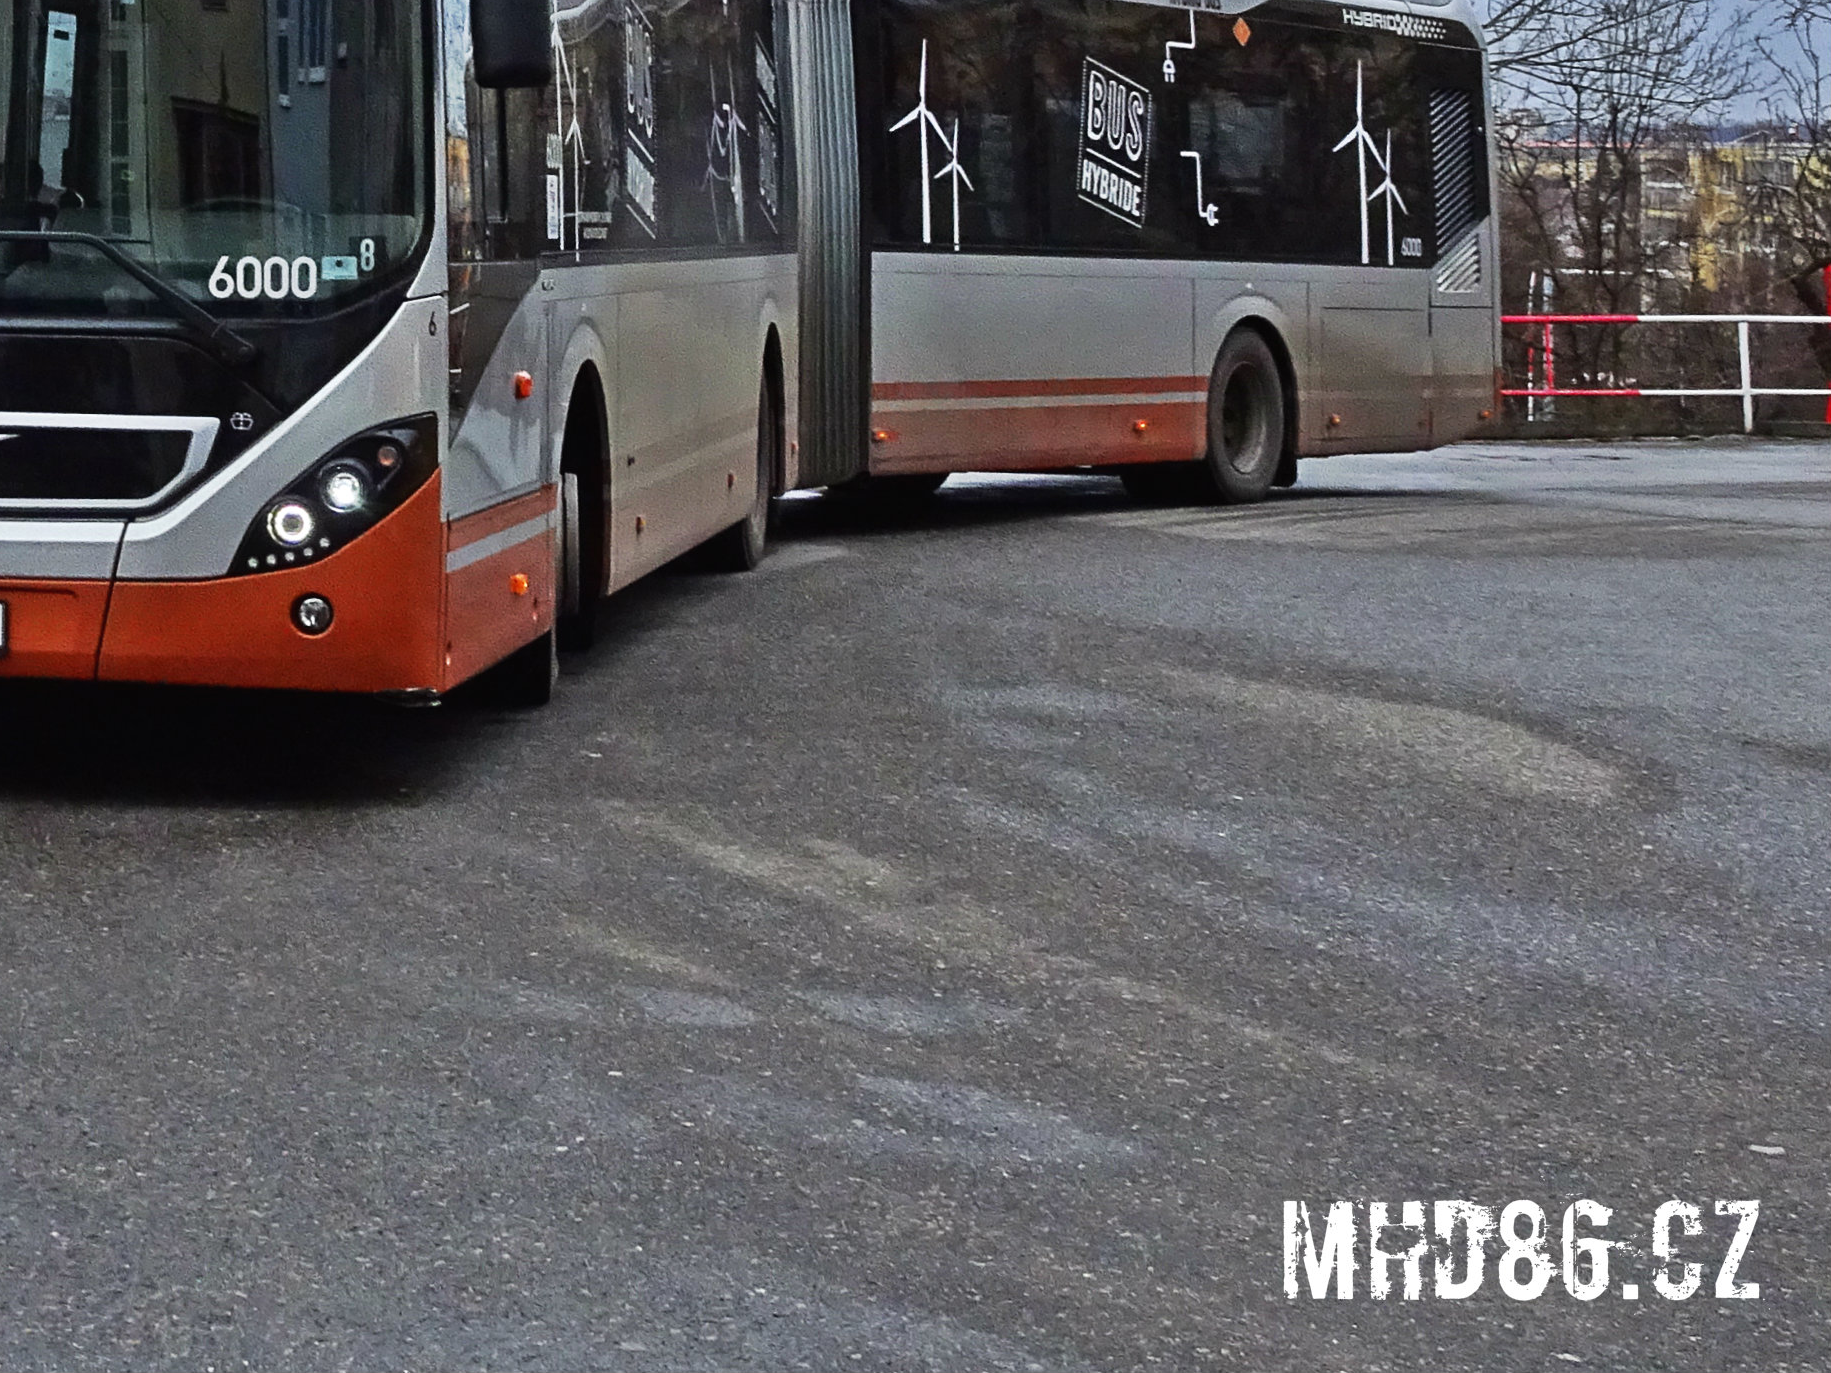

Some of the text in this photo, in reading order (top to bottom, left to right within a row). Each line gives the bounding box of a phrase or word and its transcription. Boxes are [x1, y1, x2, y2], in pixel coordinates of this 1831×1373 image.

[1342, 8, 1396, 31] HYBRID
[1087, 70, 1143, 162] BUS
[1081, 159, 1142, 217] HYBRIDE
[360, 238, 375, 271] 8
[208, 255, 317, 299] 6000
